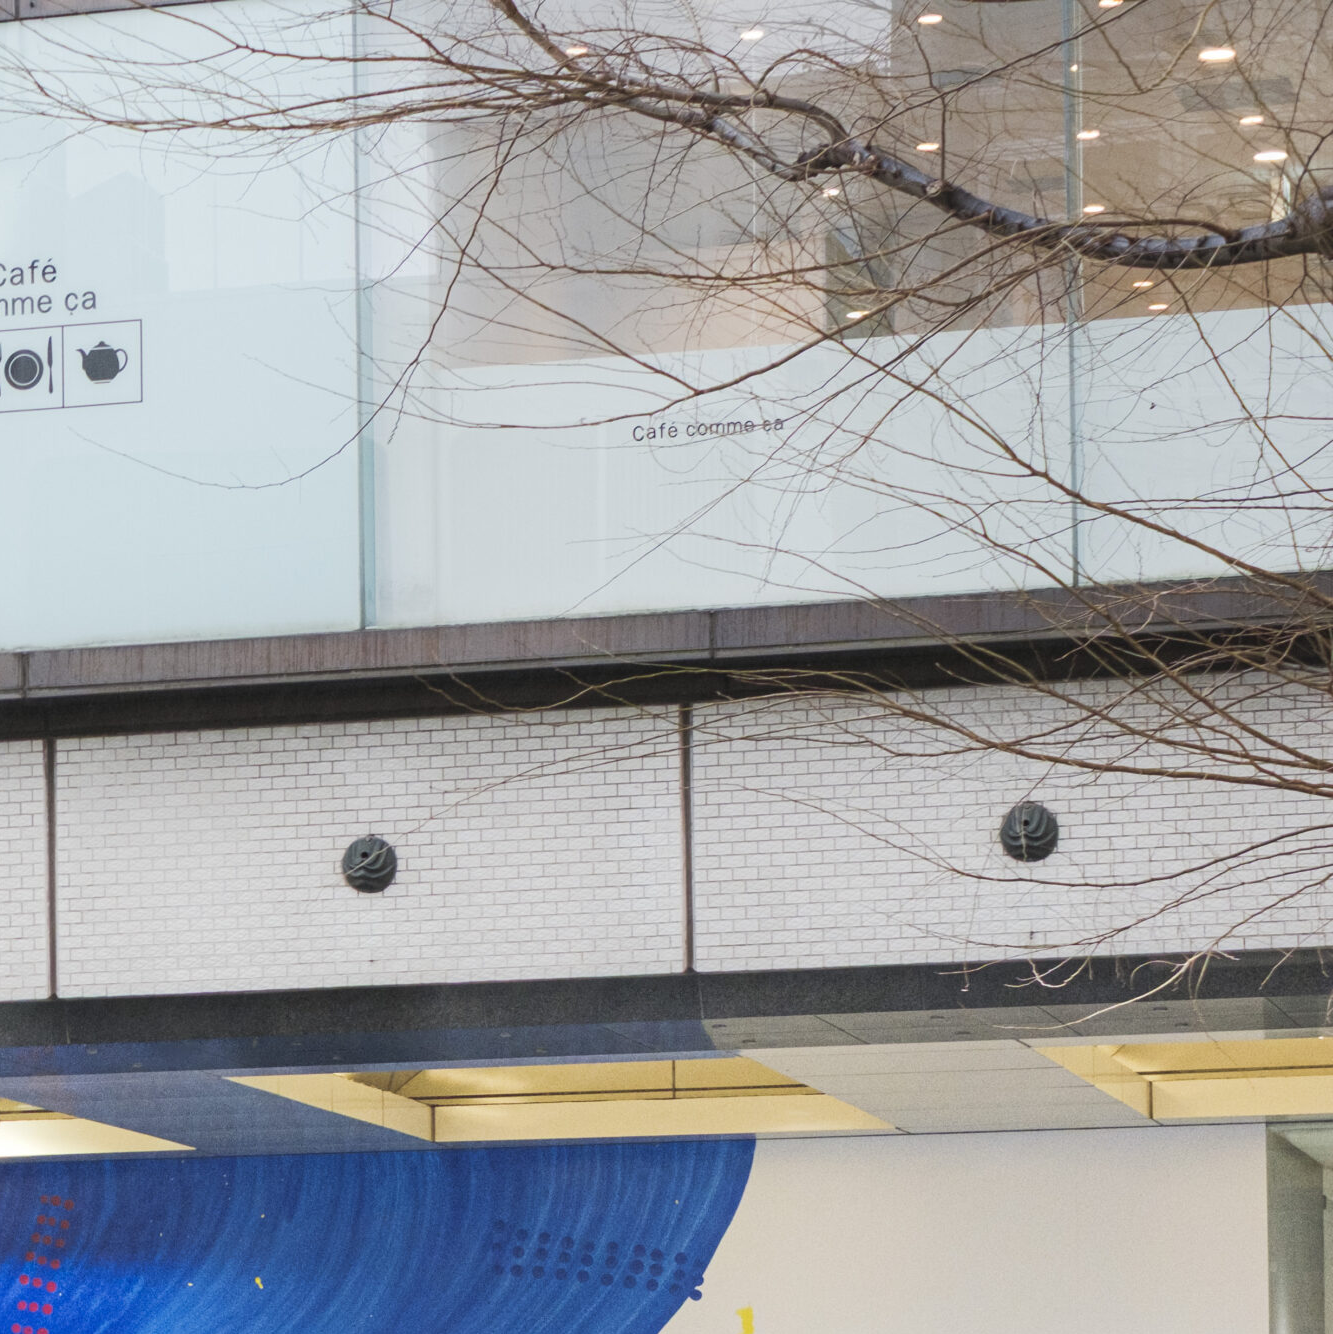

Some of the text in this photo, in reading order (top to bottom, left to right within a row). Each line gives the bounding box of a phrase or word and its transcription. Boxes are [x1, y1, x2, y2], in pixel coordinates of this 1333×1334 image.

[65, 290, 97, 316] ça
[632, 420, 678, 442] Café
[686, 419, 754, 436] comme
